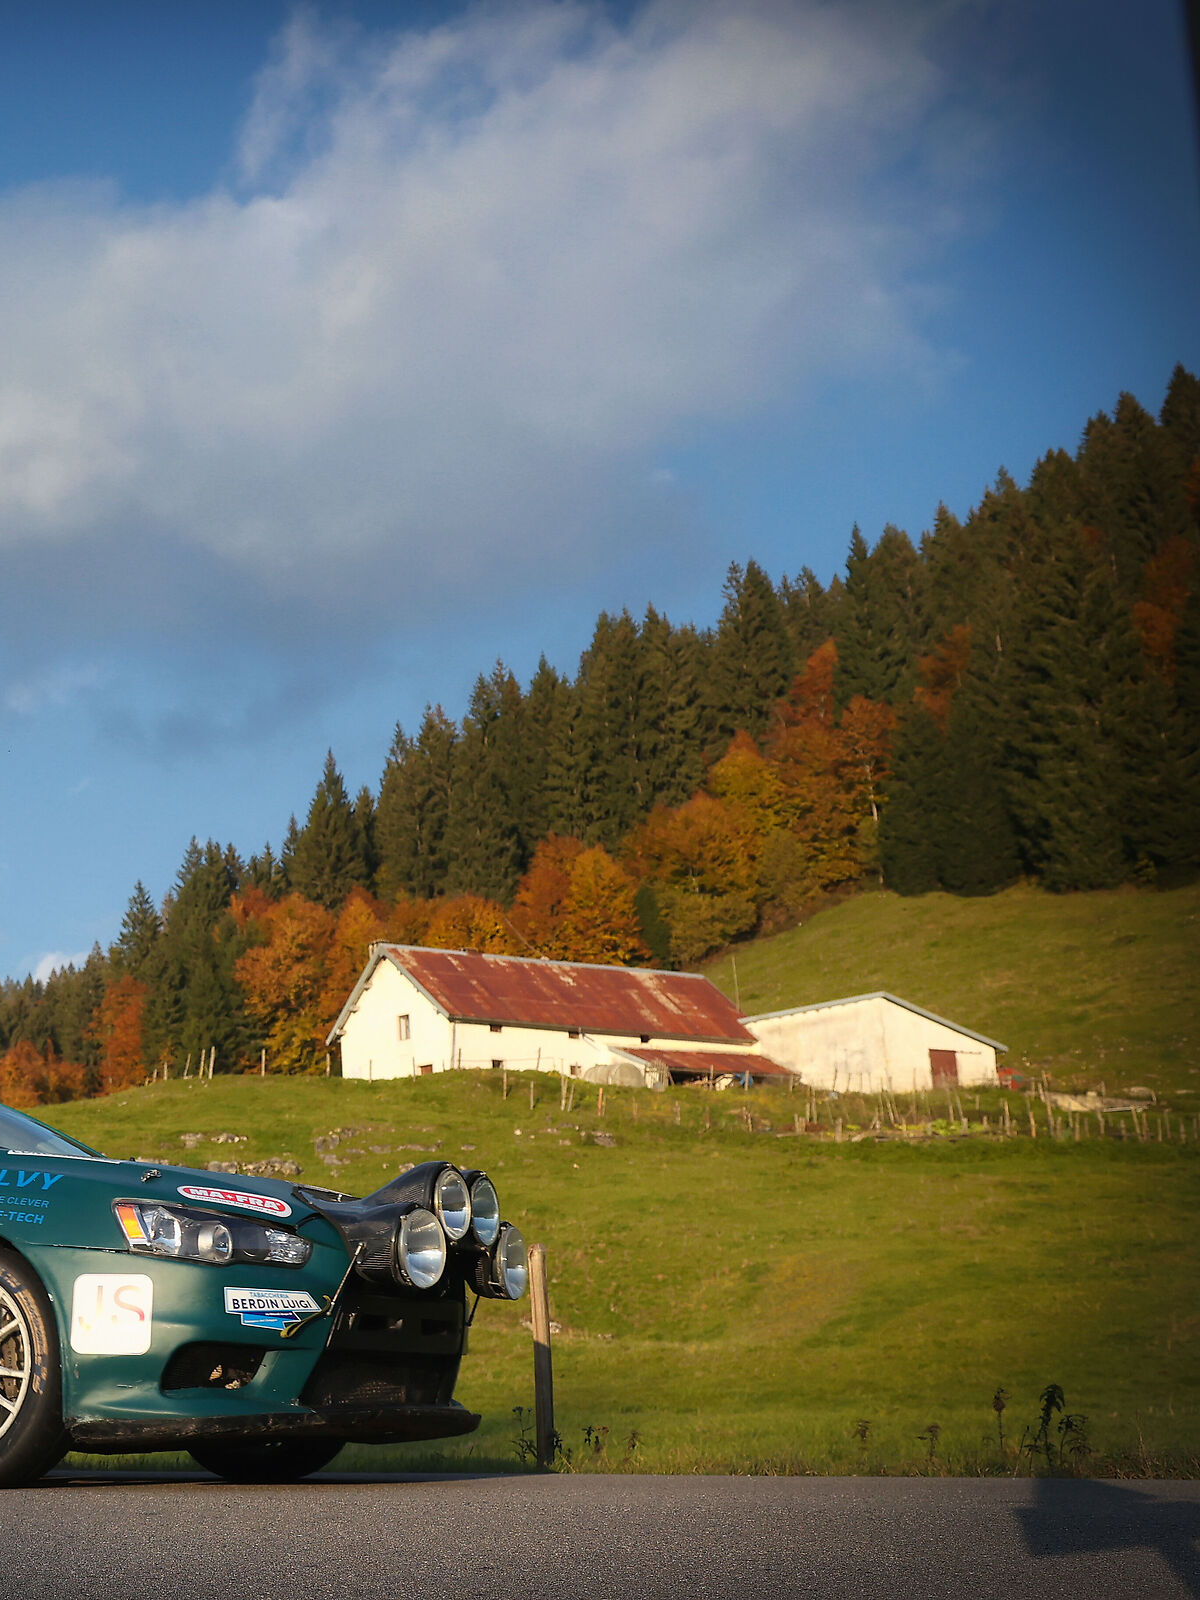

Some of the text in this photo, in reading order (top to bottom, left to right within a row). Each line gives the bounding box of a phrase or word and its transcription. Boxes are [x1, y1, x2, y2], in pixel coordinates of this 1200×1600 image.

[6, 1196, 50, 1209] CLEVER
[232, 1298, 313, 1310] BERDIN LUIGI
